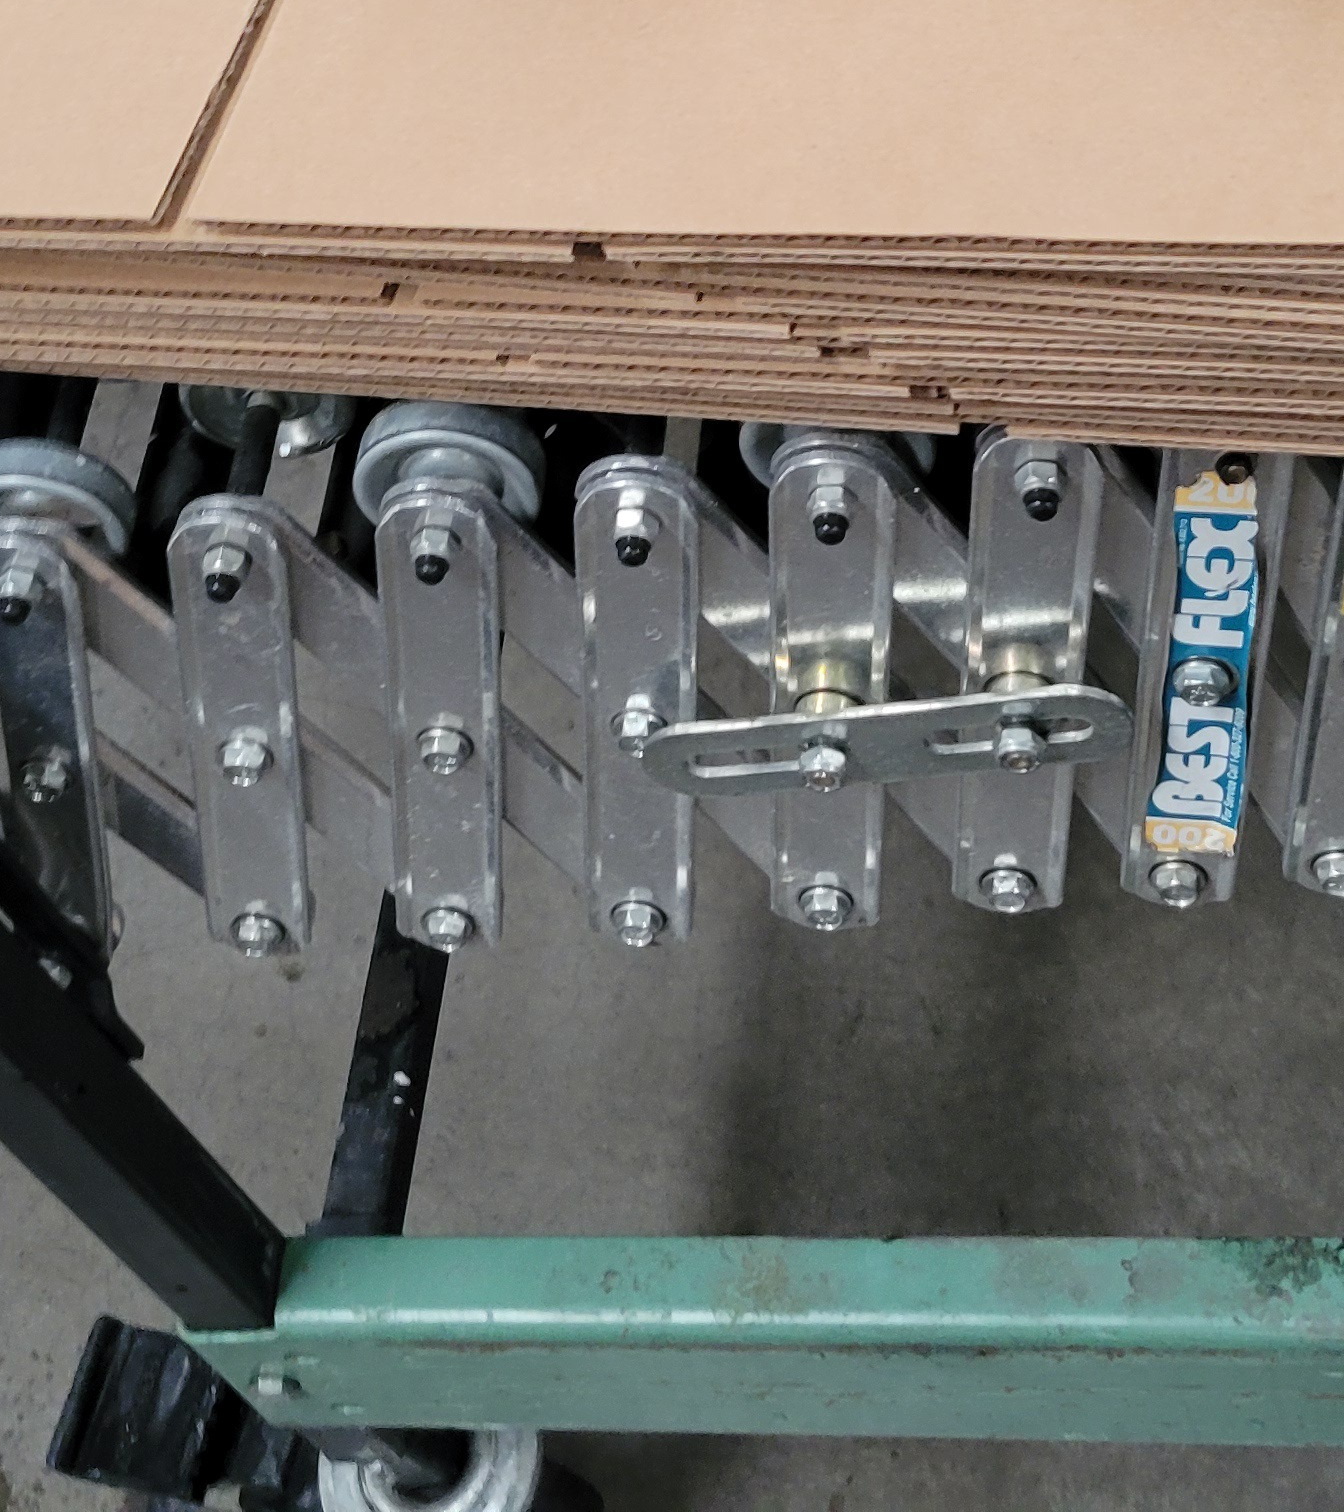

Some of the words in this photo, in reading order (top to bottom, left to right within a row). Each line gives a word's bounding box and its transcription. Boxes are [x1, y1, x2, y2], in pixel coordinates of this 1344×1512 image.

[1173, 517, 1259, 648] FLEX
[1152, 696, 1235, 817] BEST
[1152, 824, 1227, 850] 200
